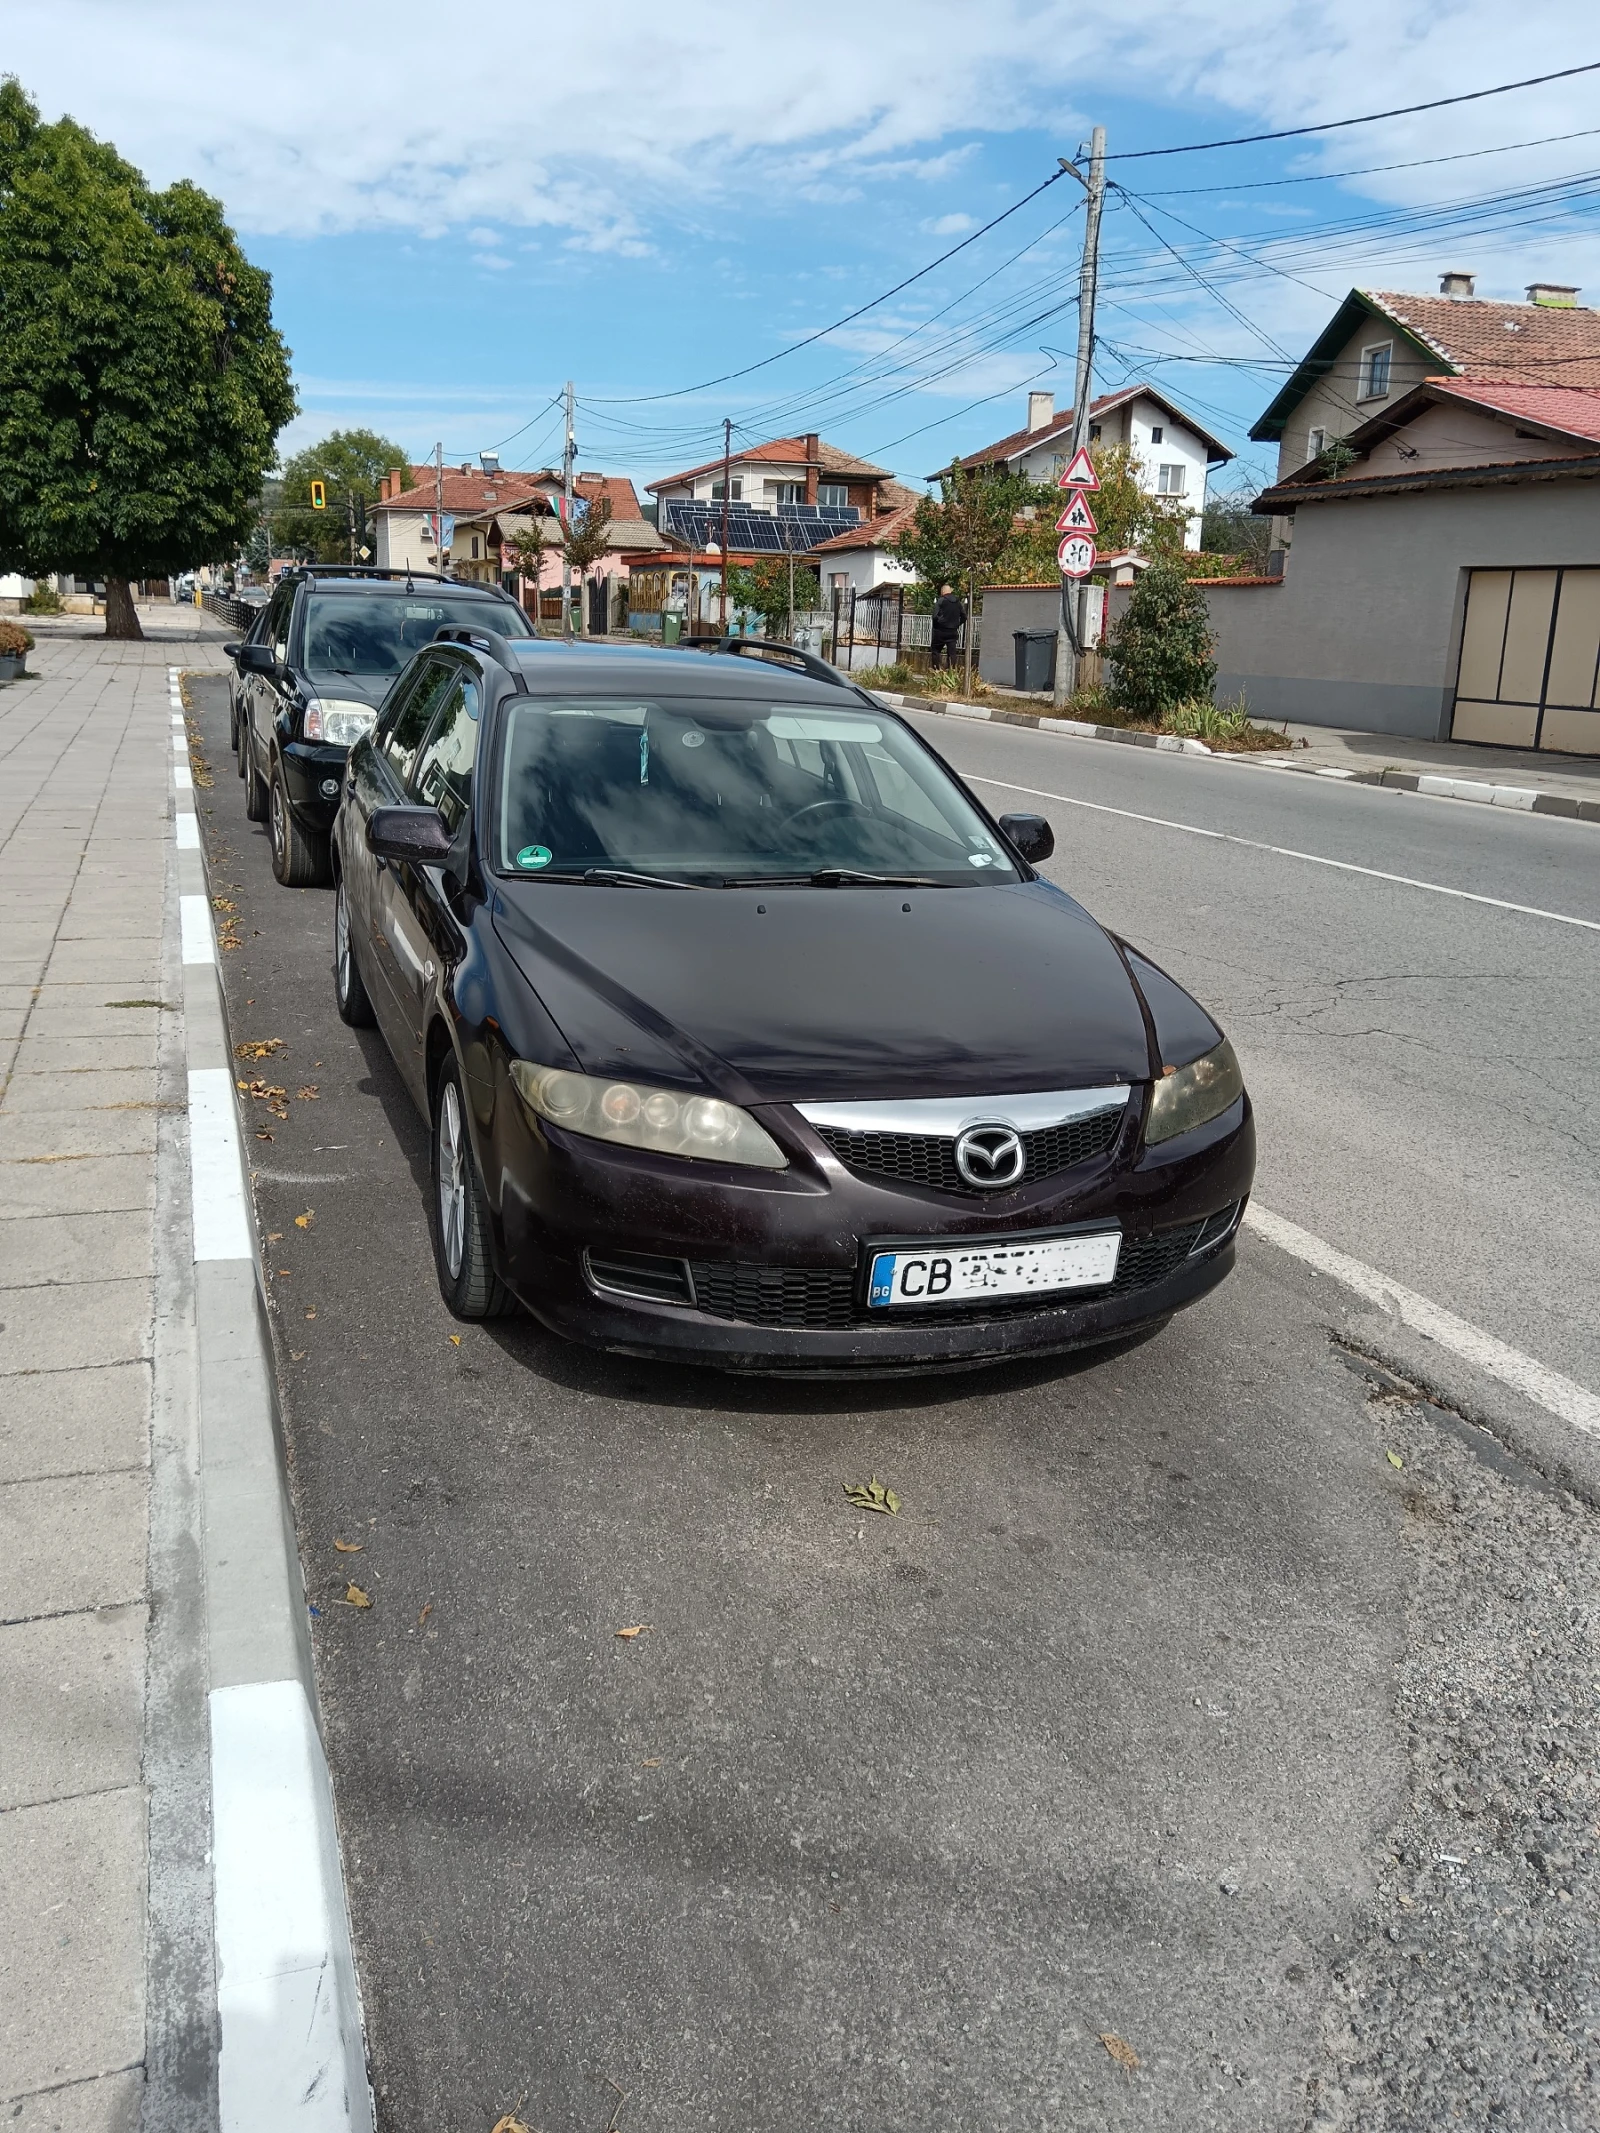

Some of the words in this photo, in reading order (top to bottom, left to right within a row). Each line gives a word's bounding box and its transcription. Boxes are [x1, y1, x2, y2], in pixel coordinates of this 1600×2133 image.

[530, 846, 540, 857] 4
[900, 1258, 952, 1297] CB
[873, 1285, 890, 1298] BG
